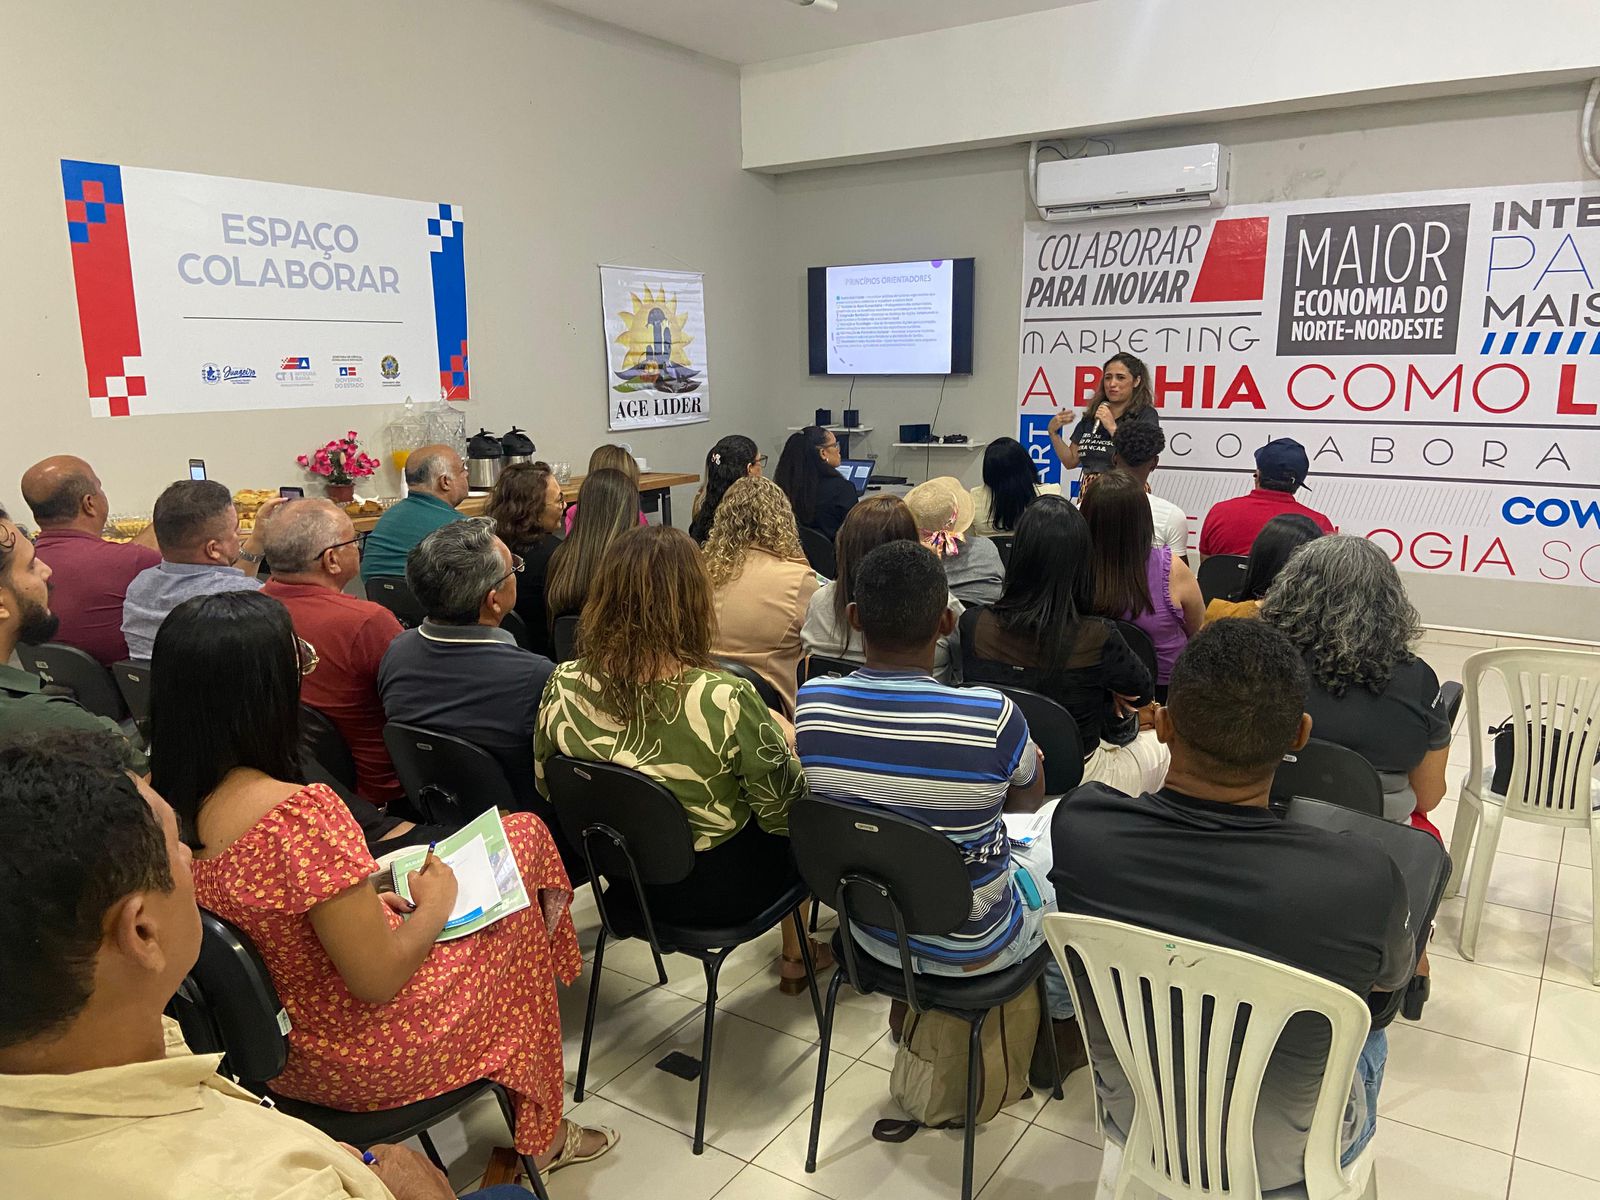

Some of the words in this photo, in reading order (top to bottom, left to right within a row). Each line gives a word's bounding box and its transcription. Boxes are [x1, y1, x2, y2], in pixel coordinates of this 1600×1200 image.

[1492, 197, 1600, 231] INTE
[221, 213, 359, 260] ESPAÇO
[1038, 225, 1202, 271] COLABORAR
[1295, 221, 1451, 286] MAIOR
[177, 253, 400, 294] COLABORAR
[881, 274, 932, 284] ORIENTADORES
[1487, 233, 1594, 292] PA
[1025, 274, 1088, 308] PARA
[1092, 269, 1190, 306] INOVAR
[1293, 286, 1407, 317] ECONOMIA
[1414, 285, 1448, 314] DO
[1022, 326, 1260, 354] MARKETING
[1291, 318, 1444, 341] NORTE-NORDESTE
[616, 399, 649, 419] AGE
[653, 397, 702, 416] LIDER
[1021, 366, 1057, 407] A
[1074, 364, 1267, 410] BHIA
[1287, 363, 1530, 414] COMO
